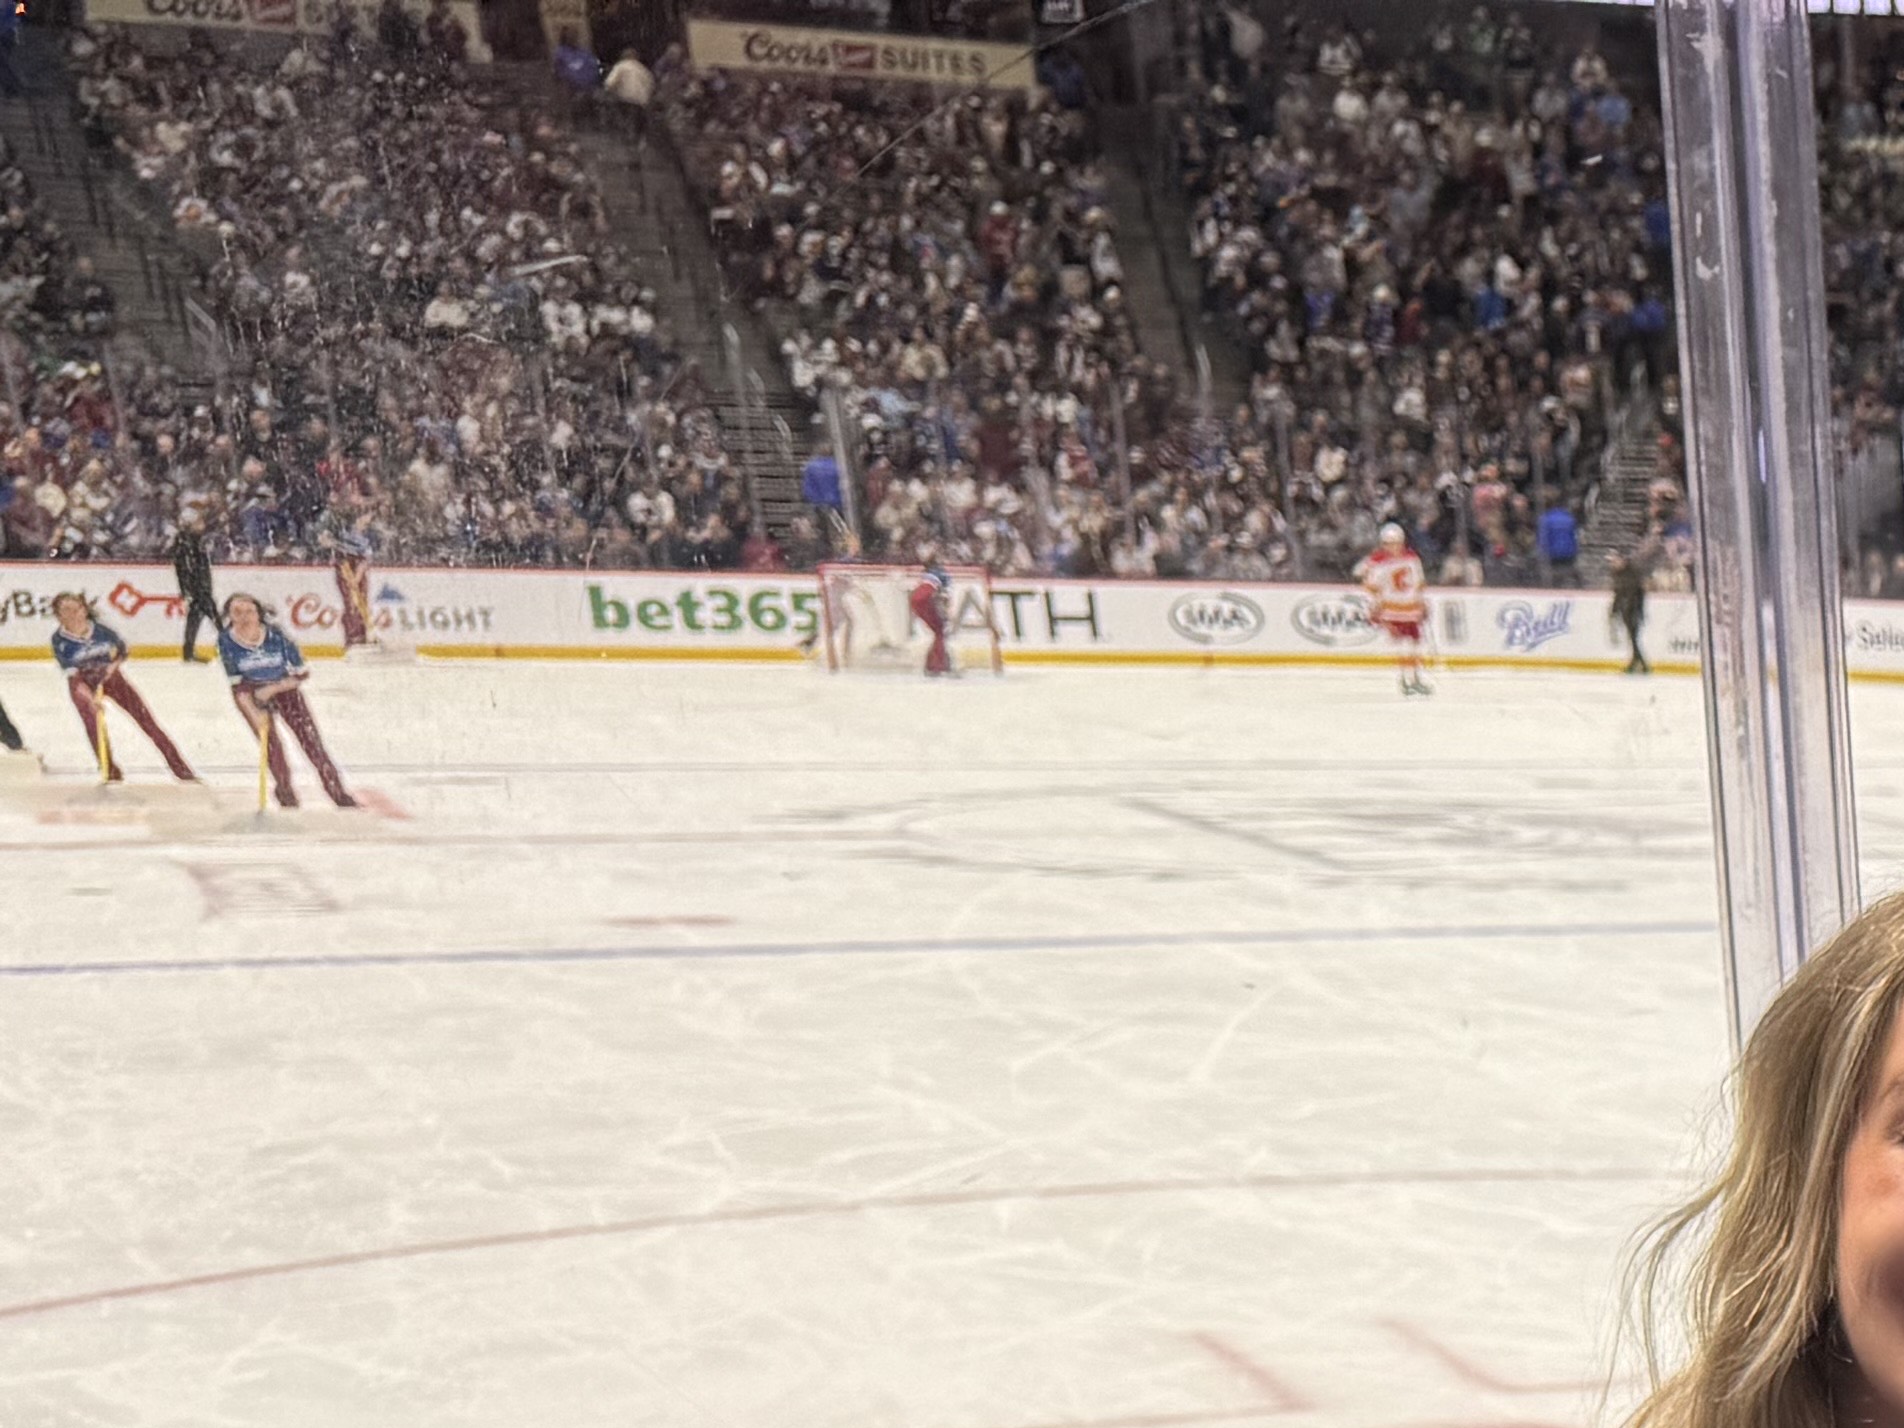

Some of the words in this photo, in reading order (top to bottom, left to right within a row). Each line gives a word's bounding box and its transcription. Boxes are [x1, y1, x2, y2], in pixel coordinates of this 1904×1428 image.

[878, 46, 990, 76] SUITES
[399, 605, 494, 632] LIGHT
[587, 583, 821, 633] bet365
